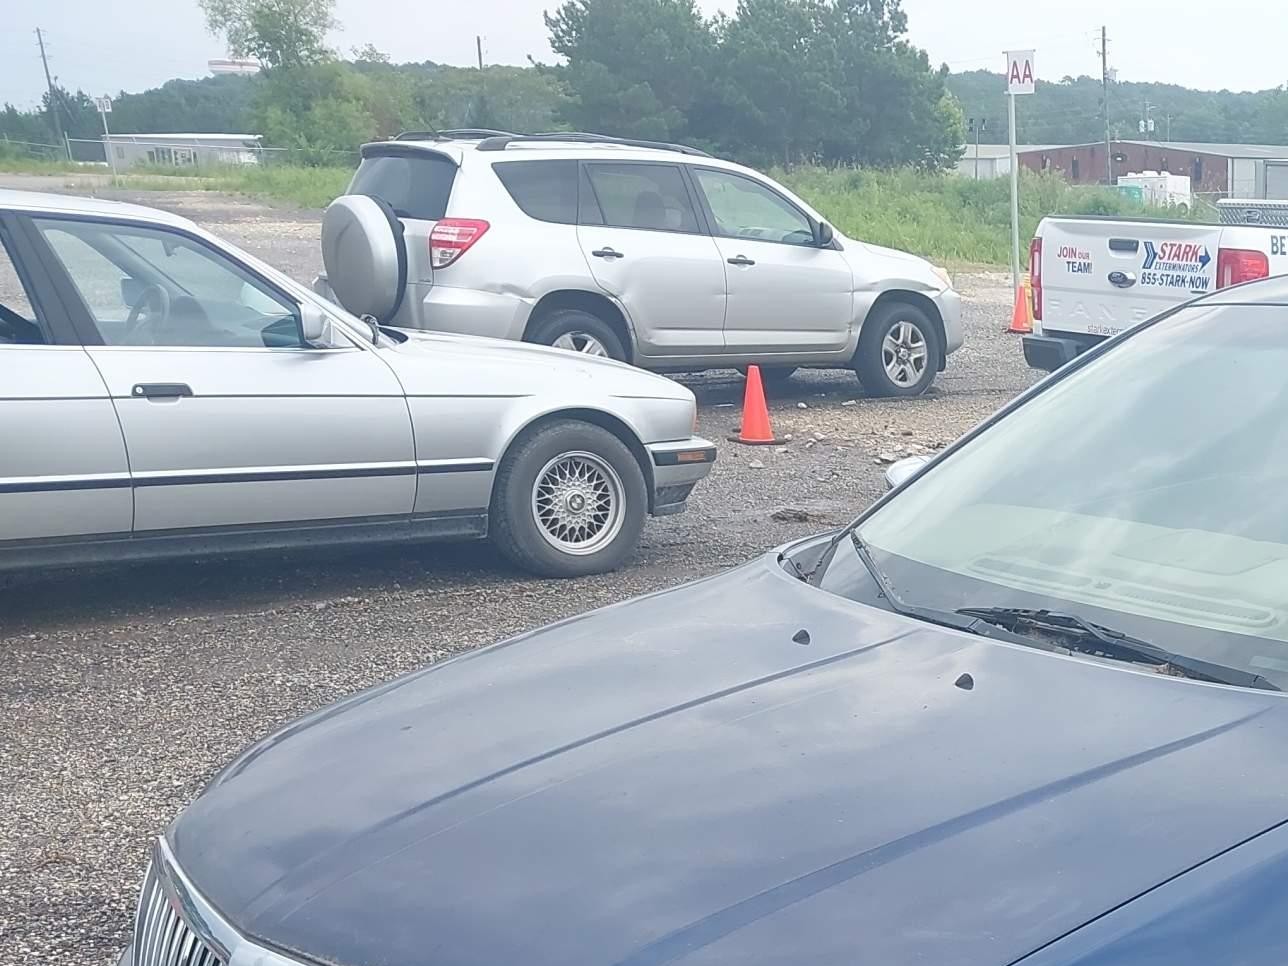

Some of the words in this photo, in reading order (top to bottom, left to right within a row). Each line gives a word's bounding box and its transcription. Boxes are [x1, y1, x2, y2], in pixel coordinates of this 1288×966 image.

[1010, 60, 1033, 84] AA
[1057, 246, 1077, 258] JOIN
[1078, 252, 1090, 260] OUR
[1158, 242, 1202, 263] STARK
[1066, 261, 1092, 274] TEAM!
[1154, 261, 1199, 273] EXTERMINATORS
